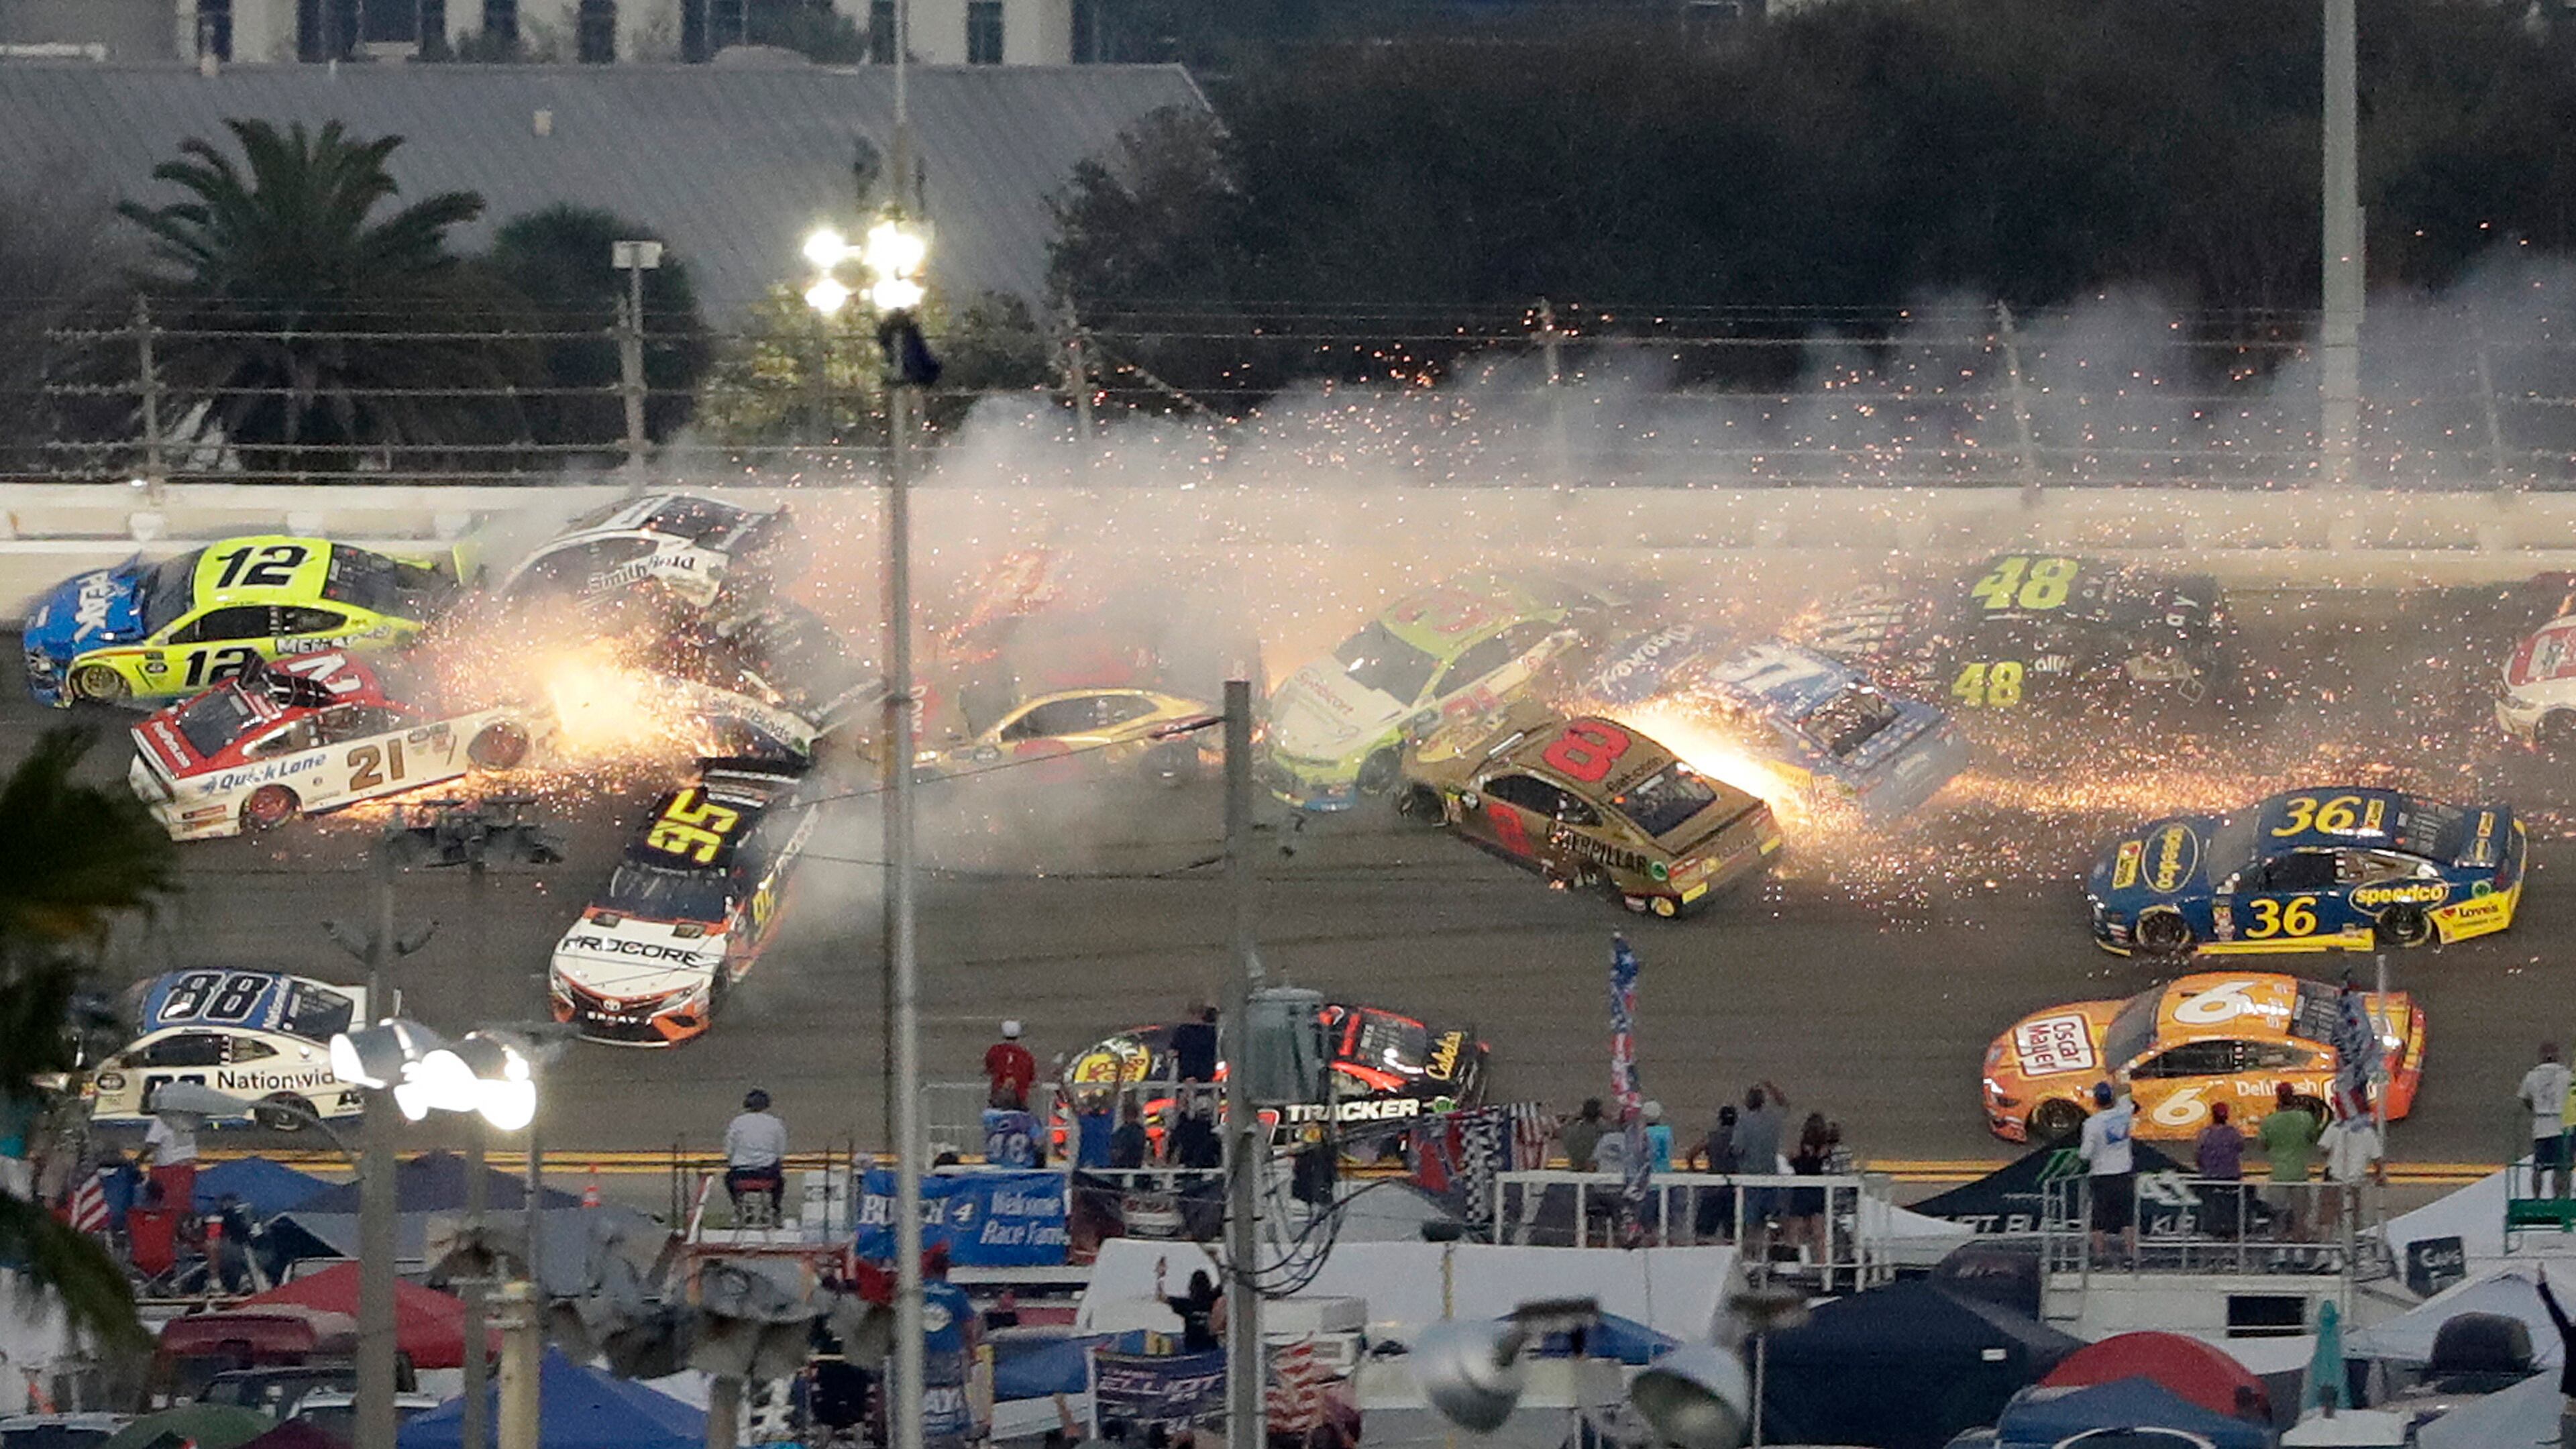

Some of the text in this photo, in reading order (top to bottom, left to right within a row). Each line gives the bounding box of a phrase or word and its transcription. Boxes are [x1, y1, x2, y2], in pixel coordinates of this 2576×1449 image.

[216, 545, 309, 588] 12
[1971, 555, 2079, 610] 48
[1951, 661, 2024, 708] 48
[279, 753, 327, 777] Lane
[347, 738, 405, 792] 21
[1544, 720, 1632, 783] 8
[647, 788, 739, 863] 95
[2271, 795, 2363, 837] 36
[2355, 885, 2445, 906] speedco
[2245, 896, 2317, 938] 36
[562, 935, 704, 968] PROCORE
[157, 971, 274, 1023] 88
[2173, 979, 2257, 1024] 6
[2025, 1024, 2056, 1068] Mayer
[2053, 1022, 2082, 1063] Oscar
[217, 1067, 343, 1091] Nationwid
[1286, 1098, 1420, 1122] TRACKER
[2152, 1087, 2207, 1126] 6
